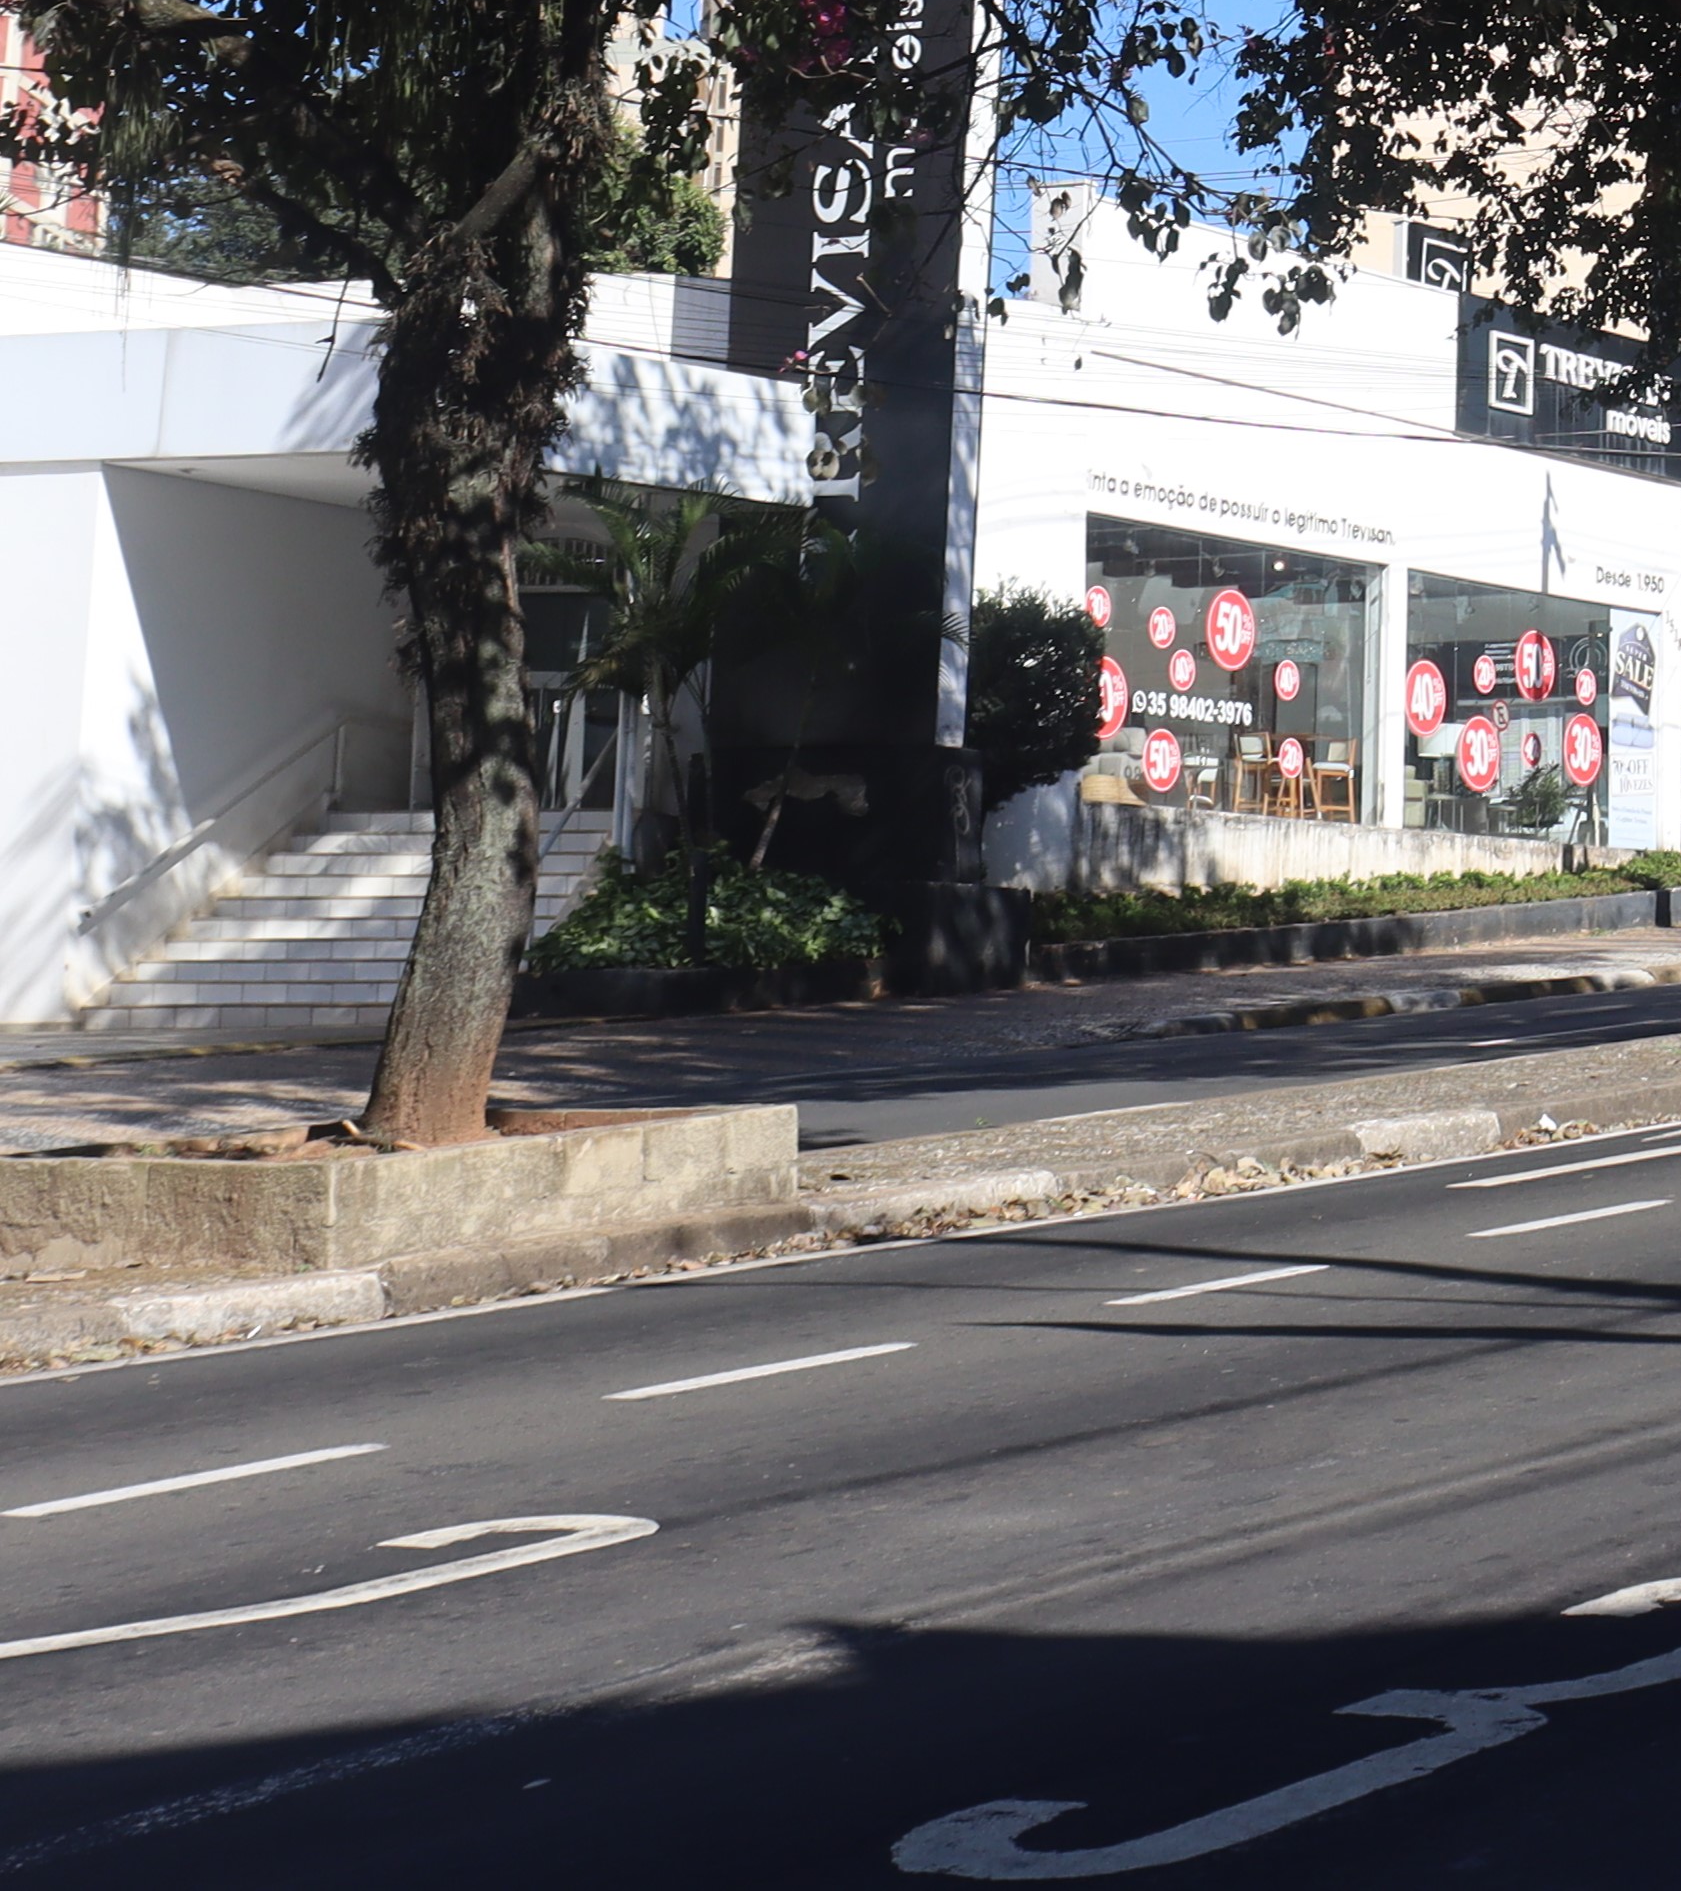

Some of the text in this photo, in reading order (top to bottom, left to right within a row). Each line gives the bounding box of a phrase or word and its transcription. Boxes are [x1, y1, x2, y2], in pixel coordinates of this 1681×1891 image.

[1606, 406, 1673, 445] móveis
[1133, 481, 1195, 511] emoção
[1199, 491, 1217, 514] de
[1596, 566, 1632, 587] Desde
[1615, 651, 1655, 692] SALE
[1148, 692, 1253, 726] 35 98402-3976
